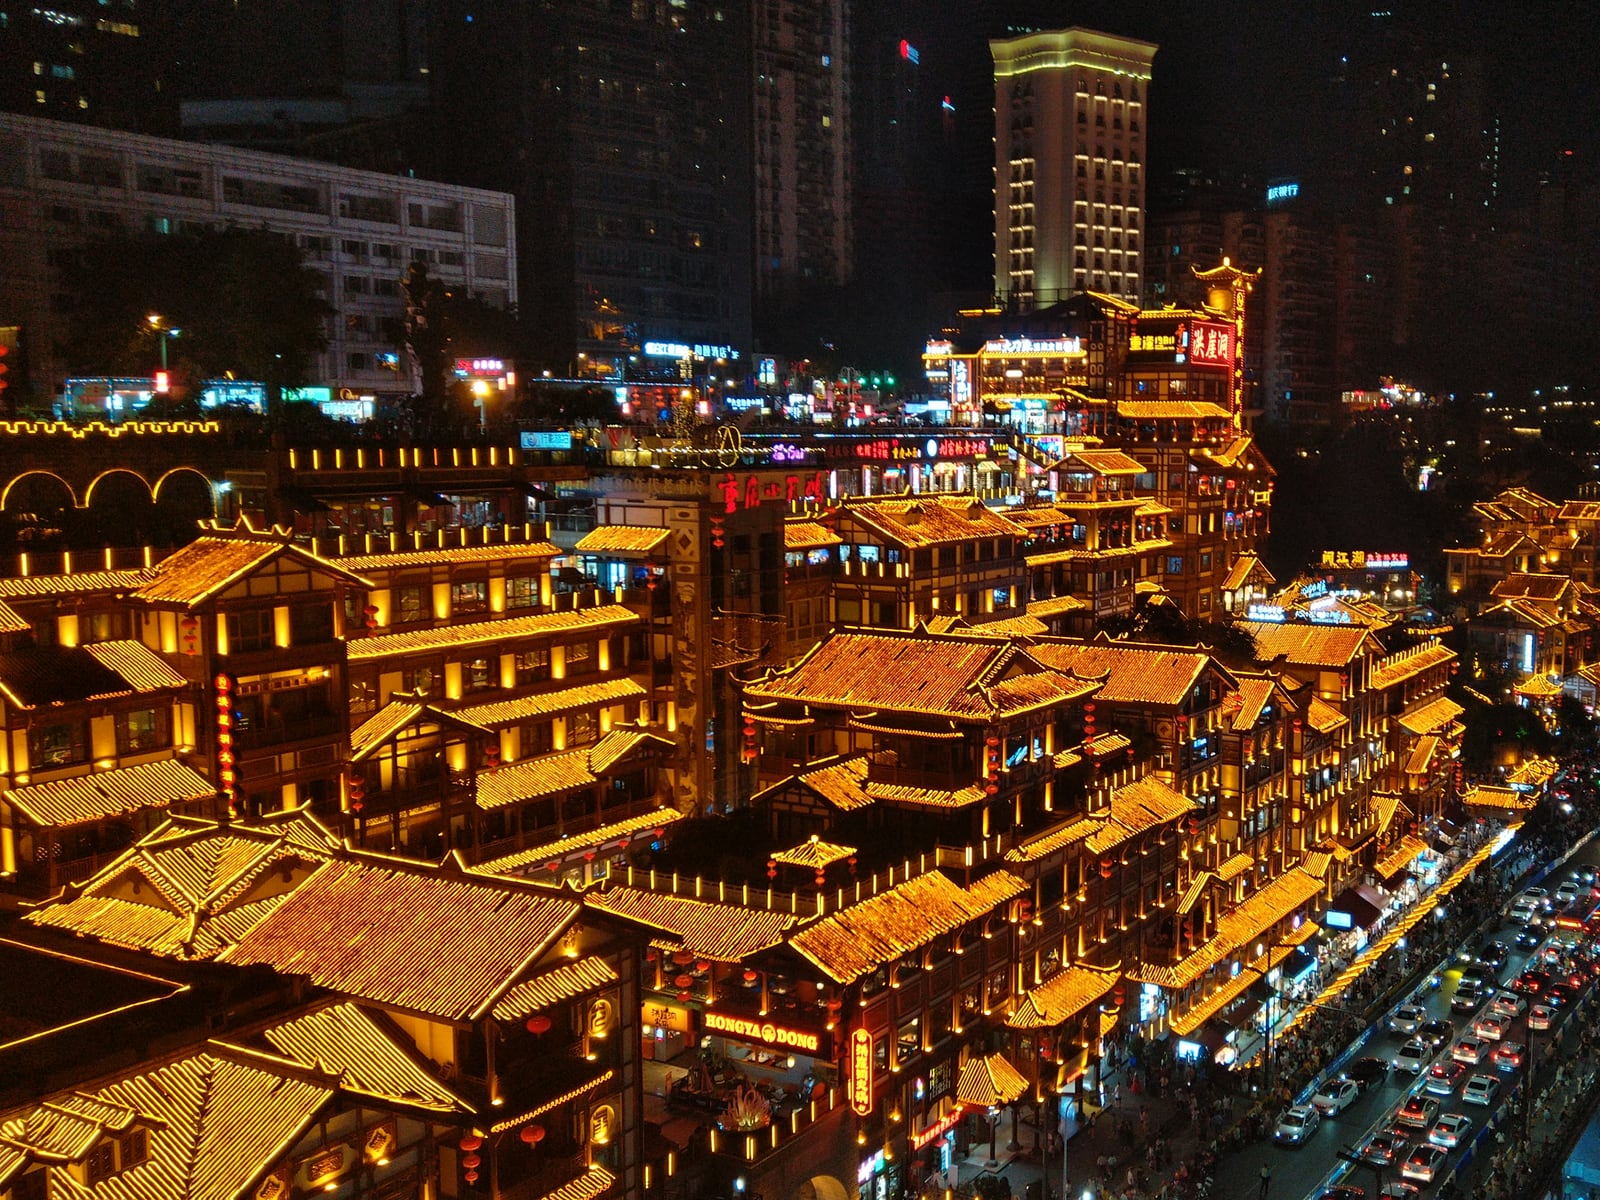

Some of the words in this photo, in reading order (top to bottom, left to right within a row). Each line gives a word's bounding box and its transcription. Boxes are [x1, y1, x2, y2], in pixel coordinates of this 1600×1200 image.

[1193, 328, 1228, 359] 洪崖洞
[705, 1013, 761, 1038] HONGYA
[776, 1027, 818, 1051] DONG
